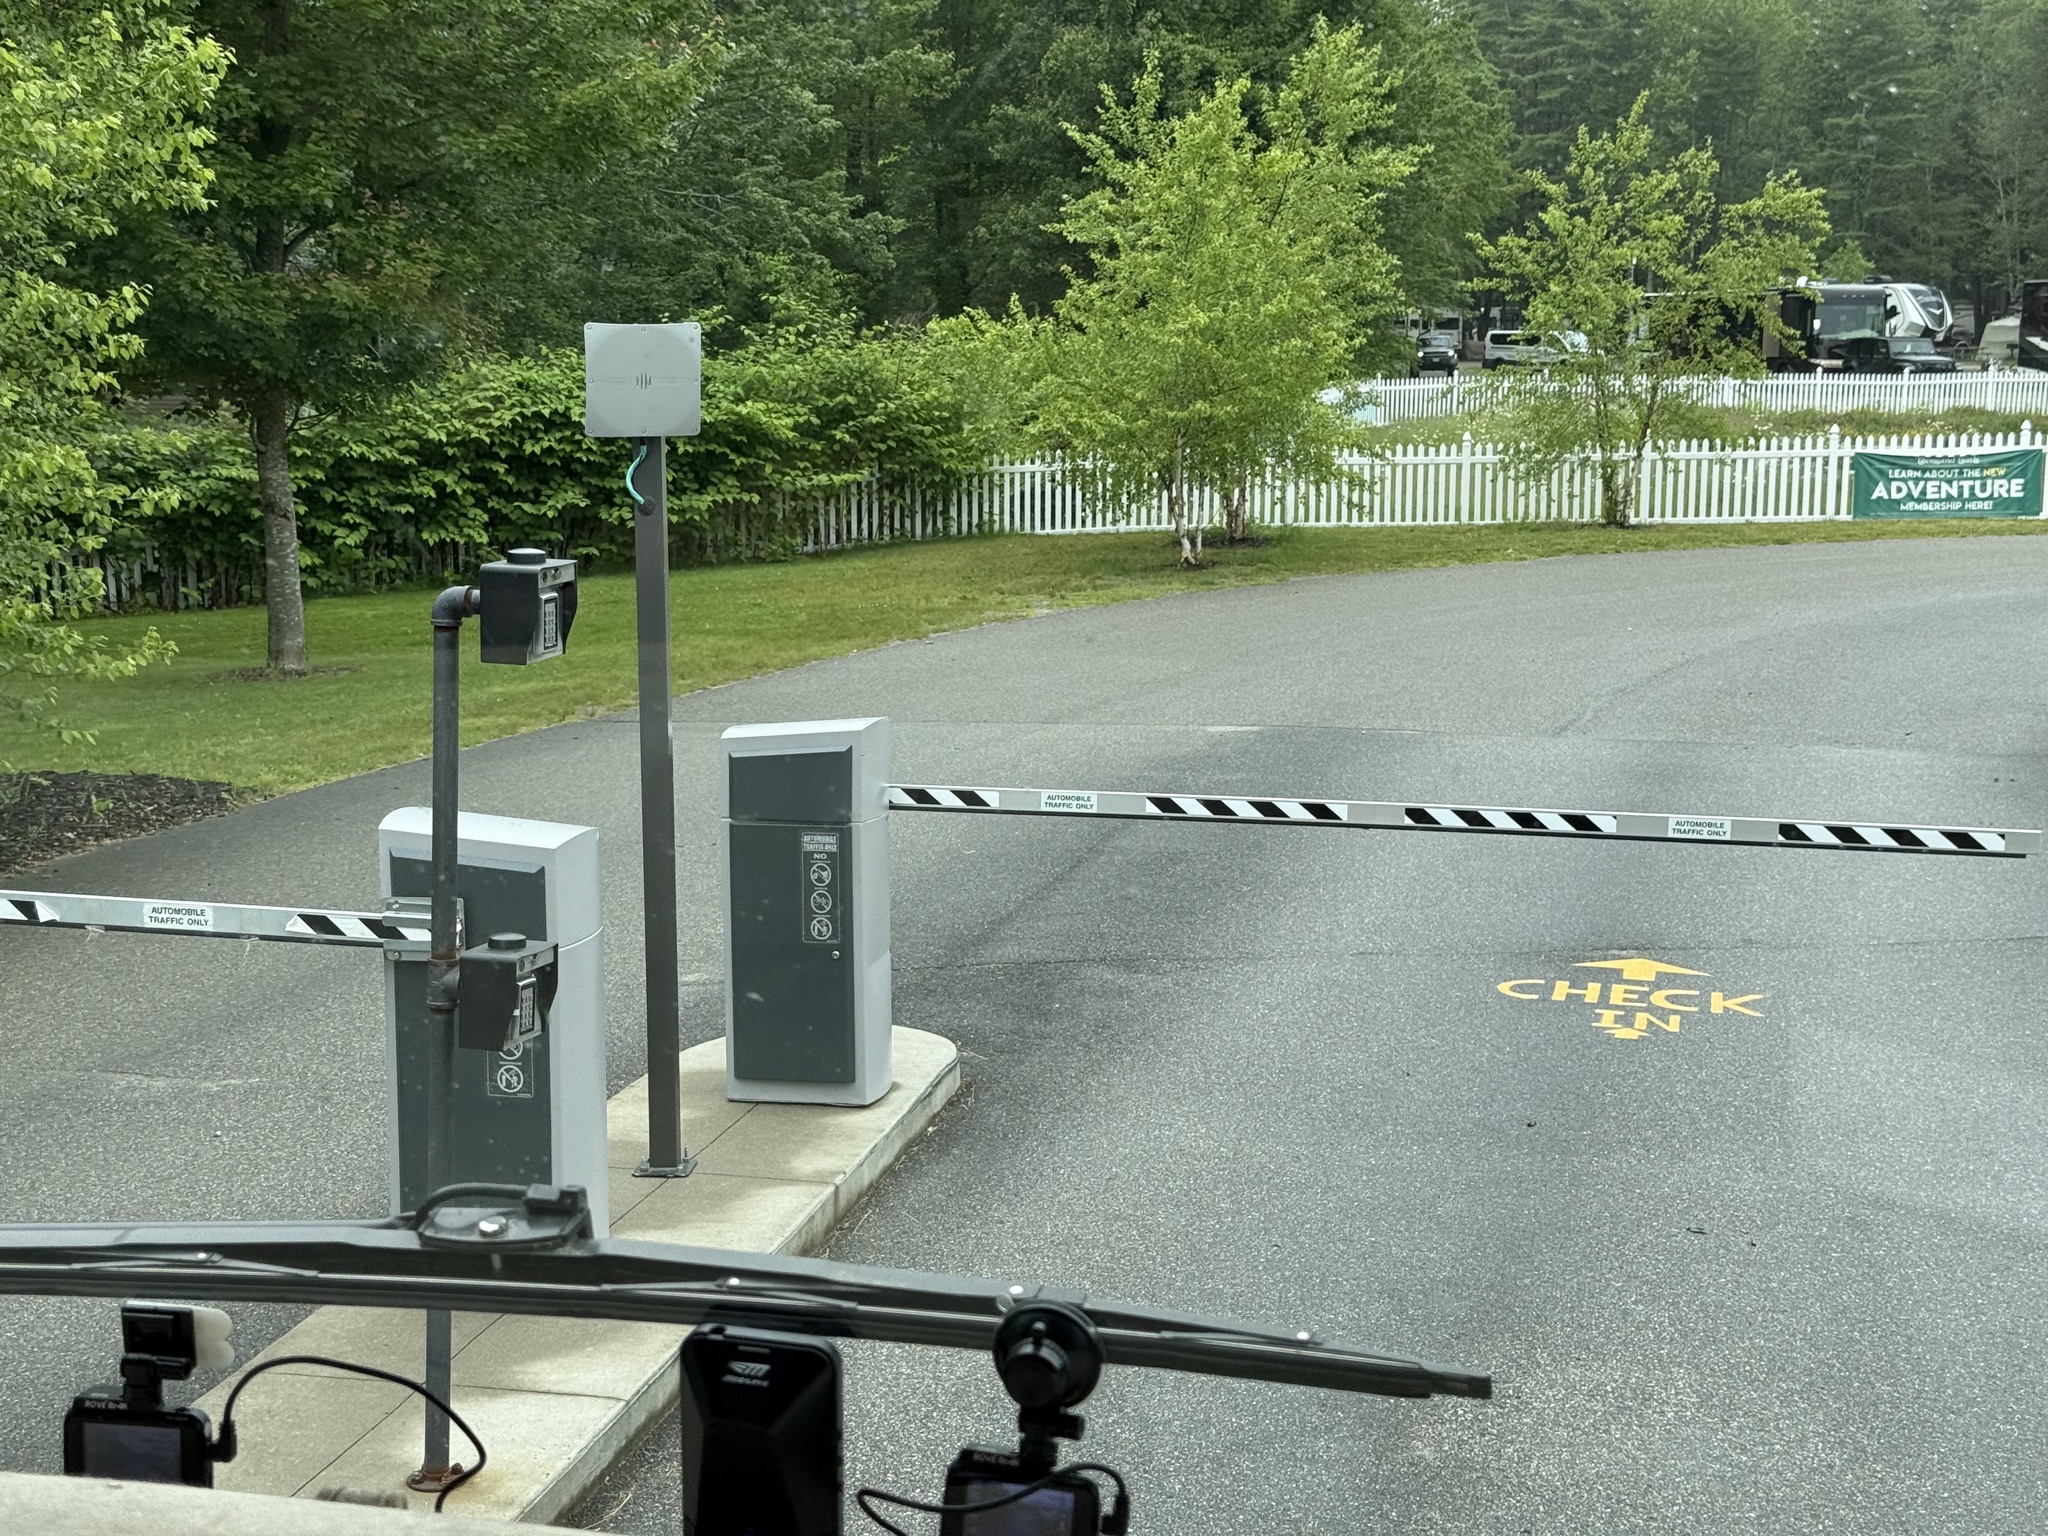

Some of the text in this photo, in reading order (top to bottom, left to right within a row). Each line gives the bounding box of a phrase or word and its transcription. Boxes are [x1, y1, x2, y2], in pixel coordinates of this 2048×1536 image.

[1889, 467, 2006, 479] LEARN ABOUT THE NEW
[1870, 478, 2025, 500] ADVENTURE
[1900, 500, 1993, 511] MEMBERSHIP HERE!
[1046, 794, 1092, 802] AUTOMOBILE
[1675, 820, 1725, 829] AUTOMOBILE
[1672, 828, 1728, 837] TRAFFIC ONLY
[151, 906, 206, 917] AUTOMOBILE
[148, 916, 209, 927] TRAFFIC ONLY
[1496, 979, 1765, 1017] CHECK
[1591, 1008, 1681, 1033] IN
